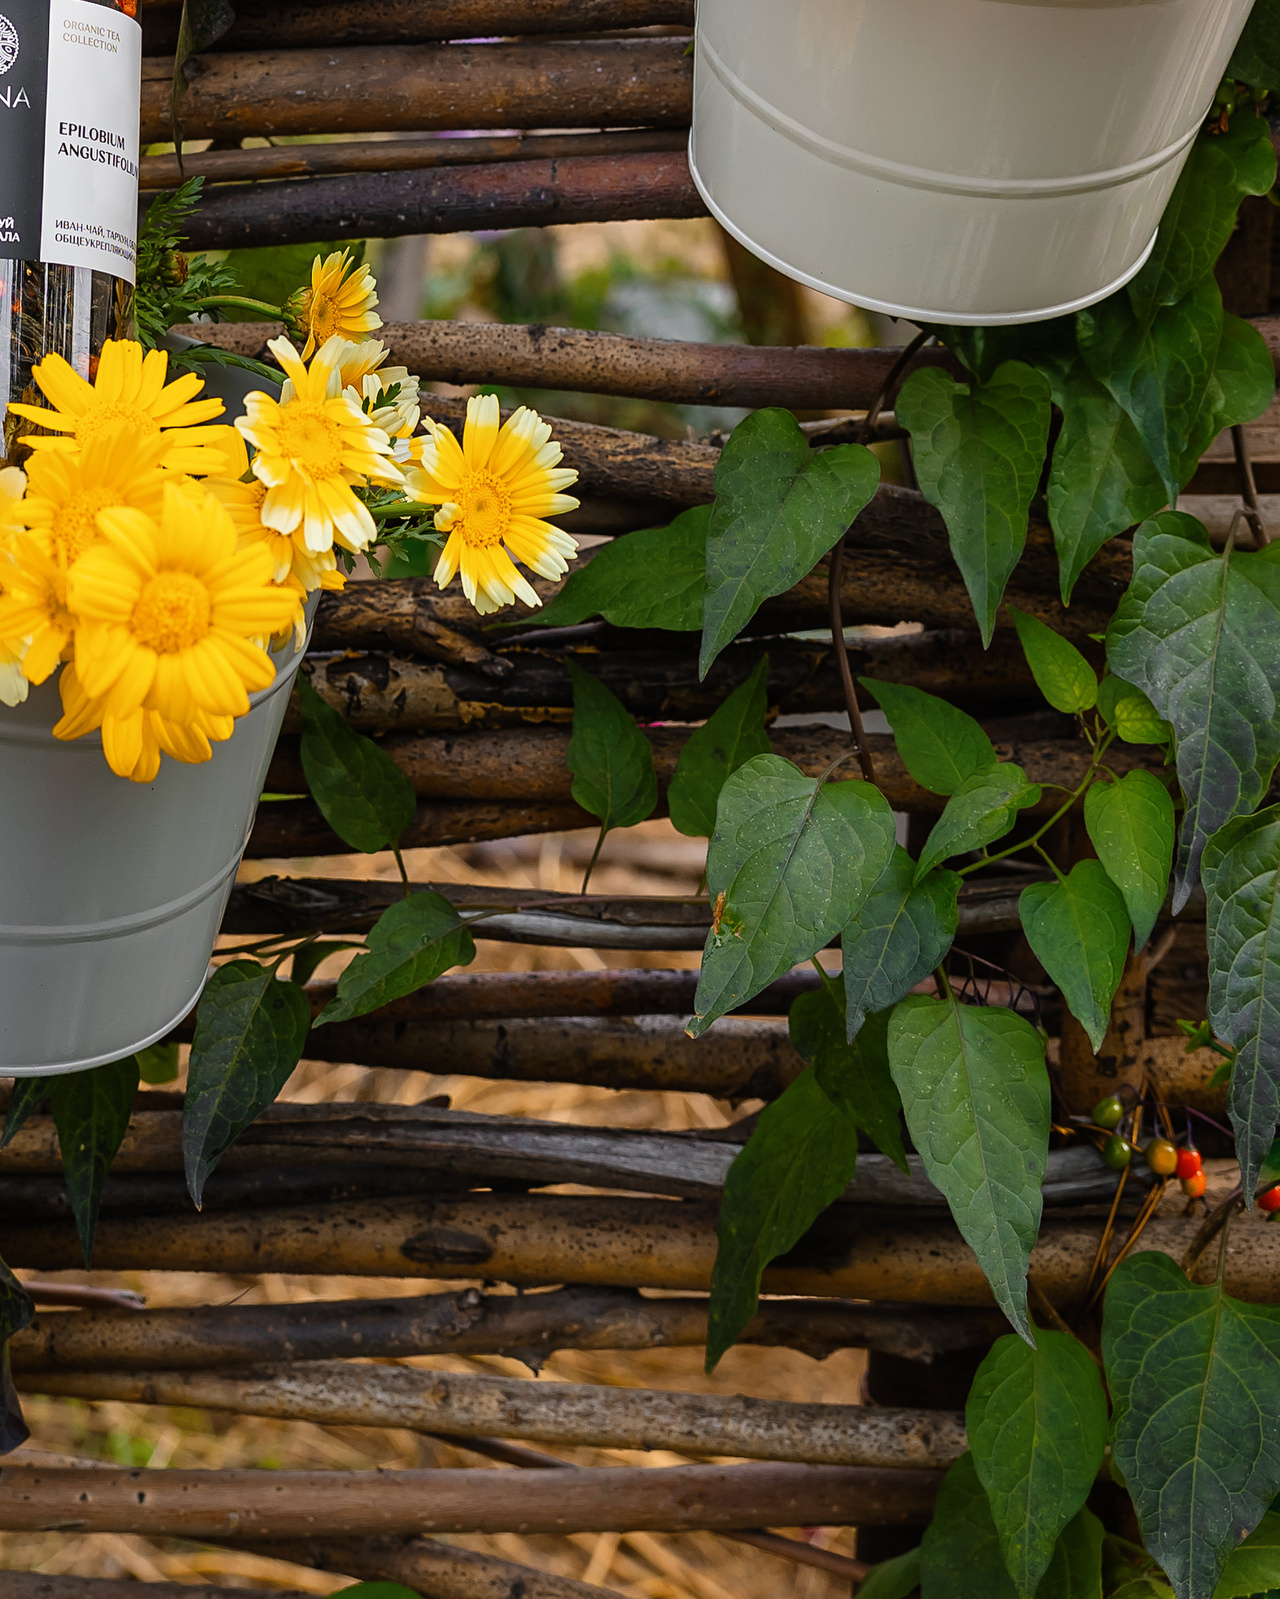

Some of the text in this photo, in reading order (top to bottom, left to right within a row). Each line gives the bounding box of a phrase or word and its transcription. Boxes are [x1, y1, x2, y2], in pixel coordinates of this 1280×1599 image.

[62, 18, 121, 42] ORGANIC TEA
[62, 31, 119, 54] COLLECTION
[59, 121, 125, 151] EPILOBIUM
[55, 219, 105, 239] ИВАН-ЧАЙ,
